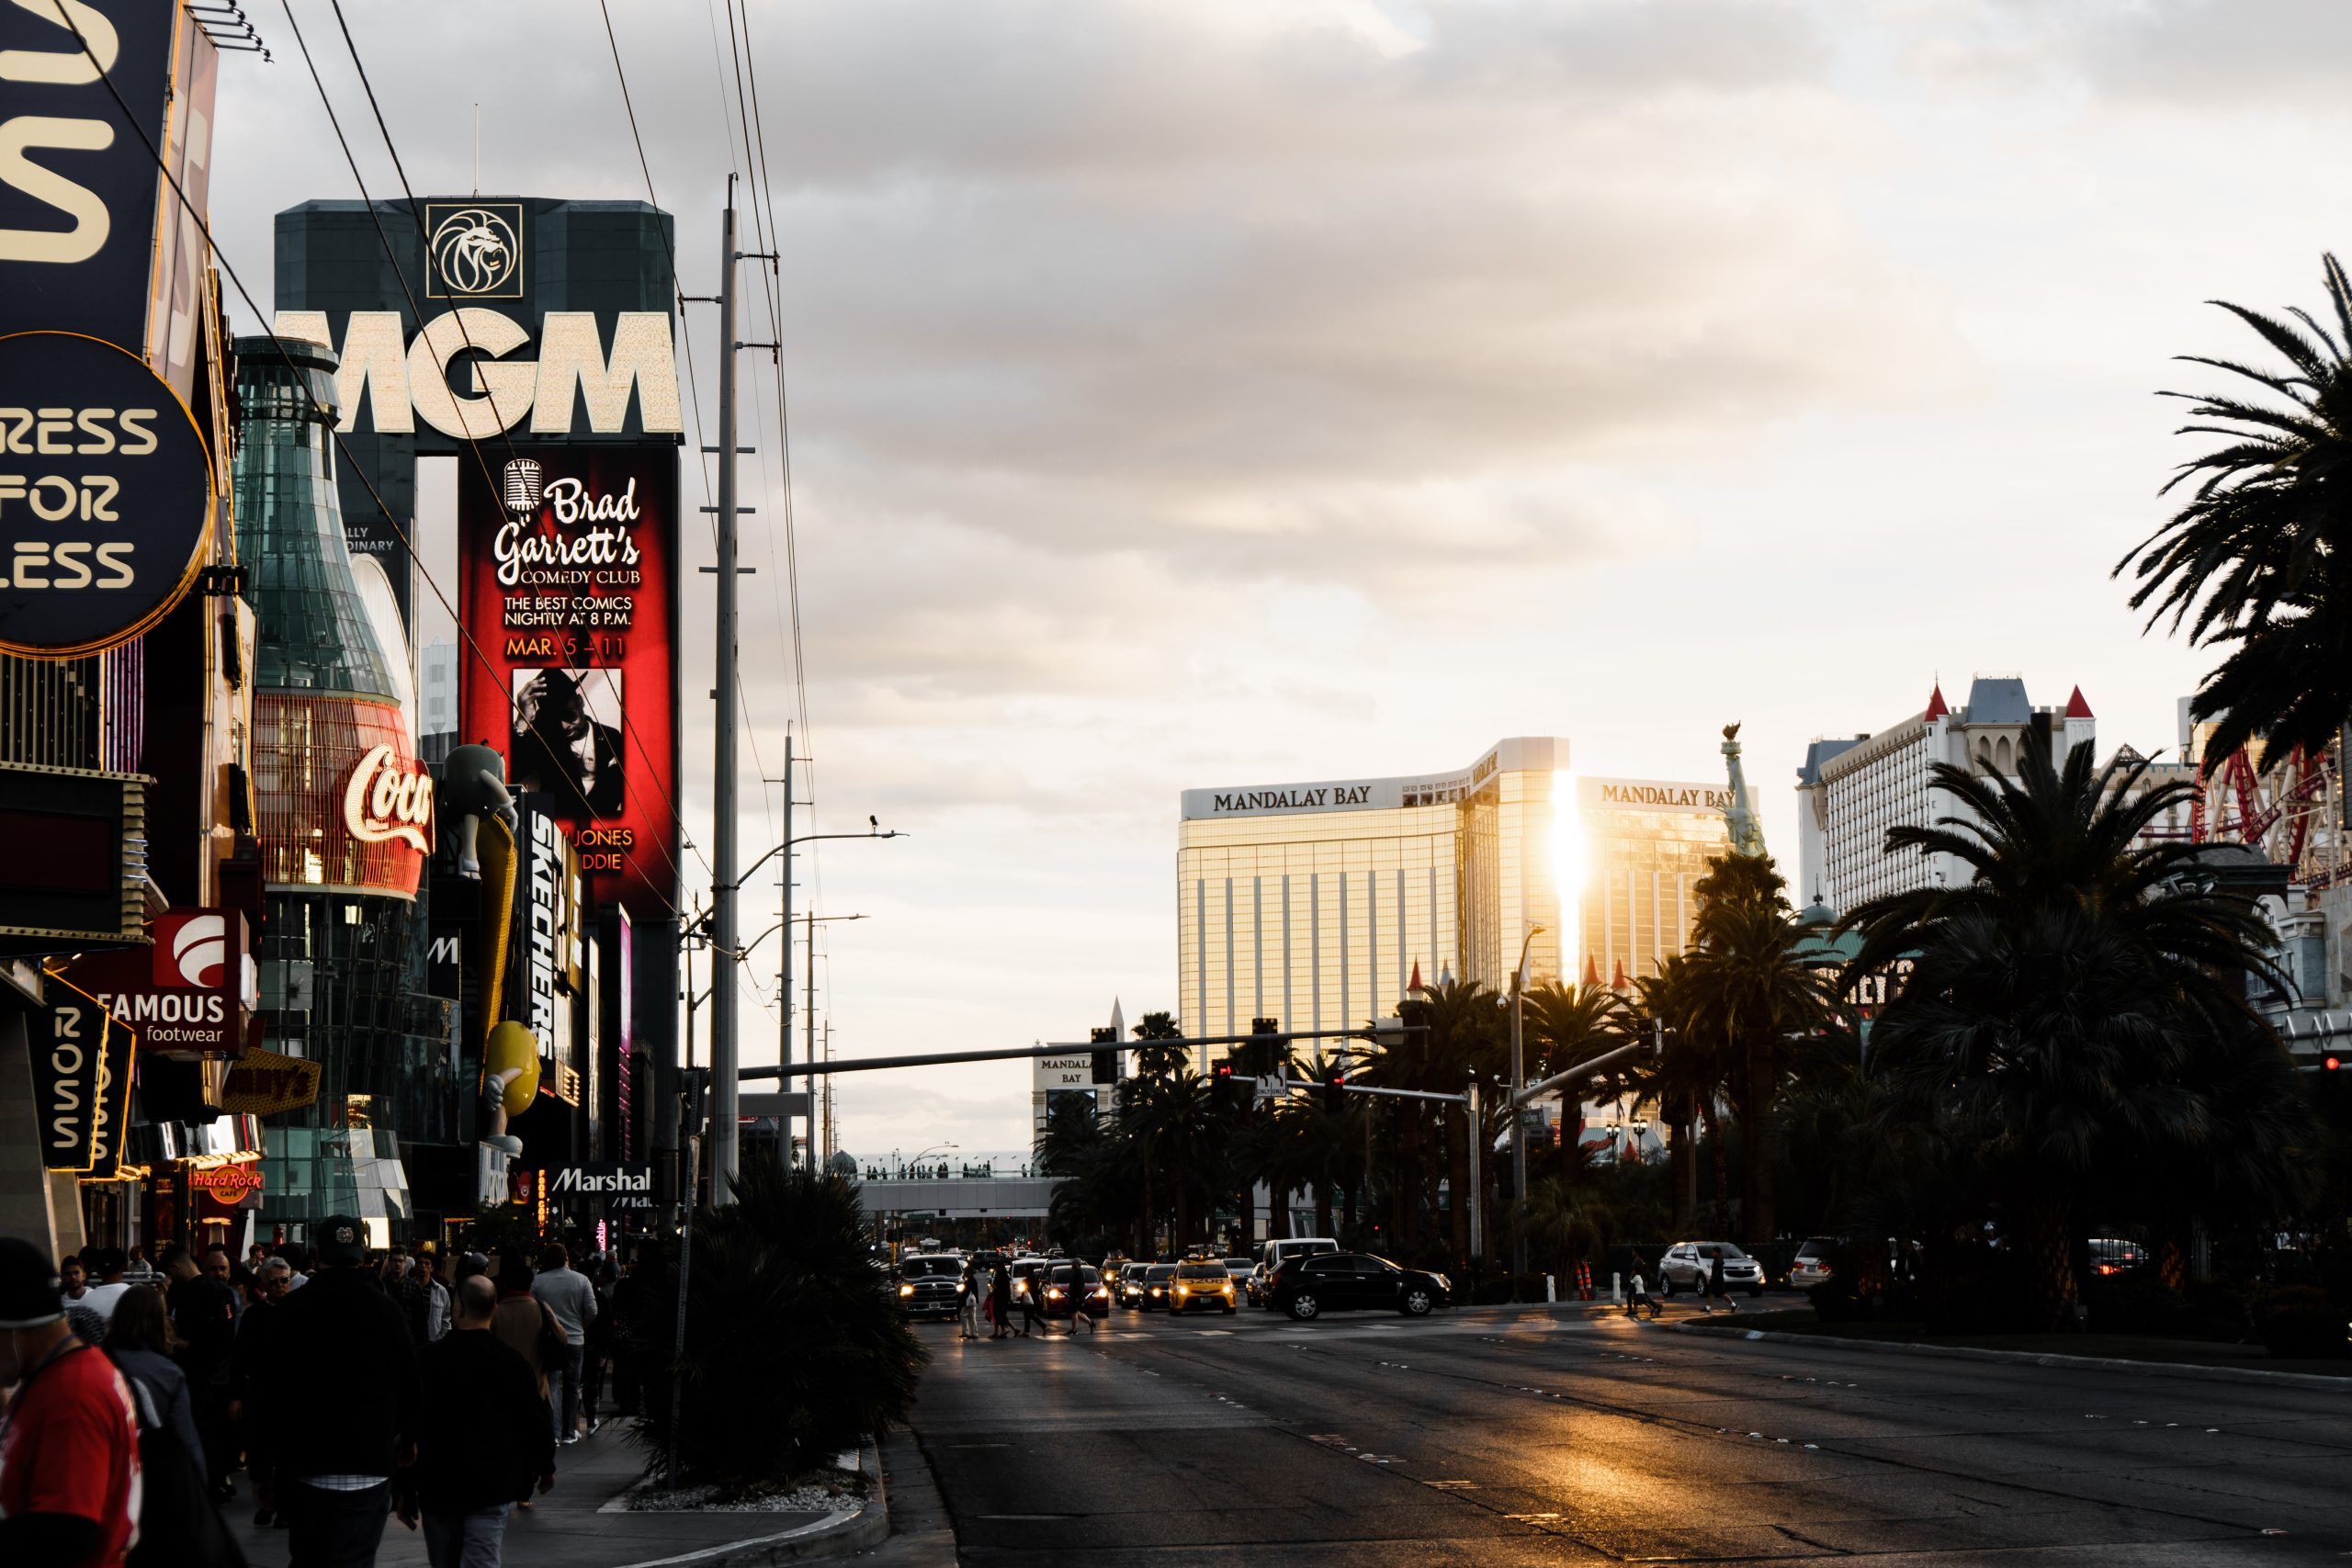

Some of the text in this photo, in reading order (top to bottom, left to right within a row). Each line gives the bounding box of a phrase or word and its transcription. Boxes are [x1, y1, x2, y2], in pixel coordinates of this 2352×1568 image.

[275, 307, 683, 439] MGM
[0, 475, 119, 521] FOR
[543, 477, 640, 524] Brad
[0, 542, 134, 588] ESS
[494, 521, 640, 585] Garrett's
[520, 570, 640, 583] COMEDY CLUB
[504, 597, 632, 610] THE BEST COMICS
[504, 613, 631, 626] NIGHTLY AT 8 P.M.
[506, 637, 558, 656] MAR.
[345, 743, 433, 857] Coca
[1214, 785, 1372, 811] MANDALAY BAY
[1602, 784, 1736, 807] MANDALAY BAY
[573, 829, 633, 847] JONES
[531, 810, 552, 1060] SKECHERS
[98, 994, 224, 1022] FAMOUS
[147, 1026, 223, 1043] footwear
[51, 1007, 84, 1148] ROSS
[1062, 1074, 1081, 1083] BAY
[194, 1173, 263, 1190] Hard Rock
